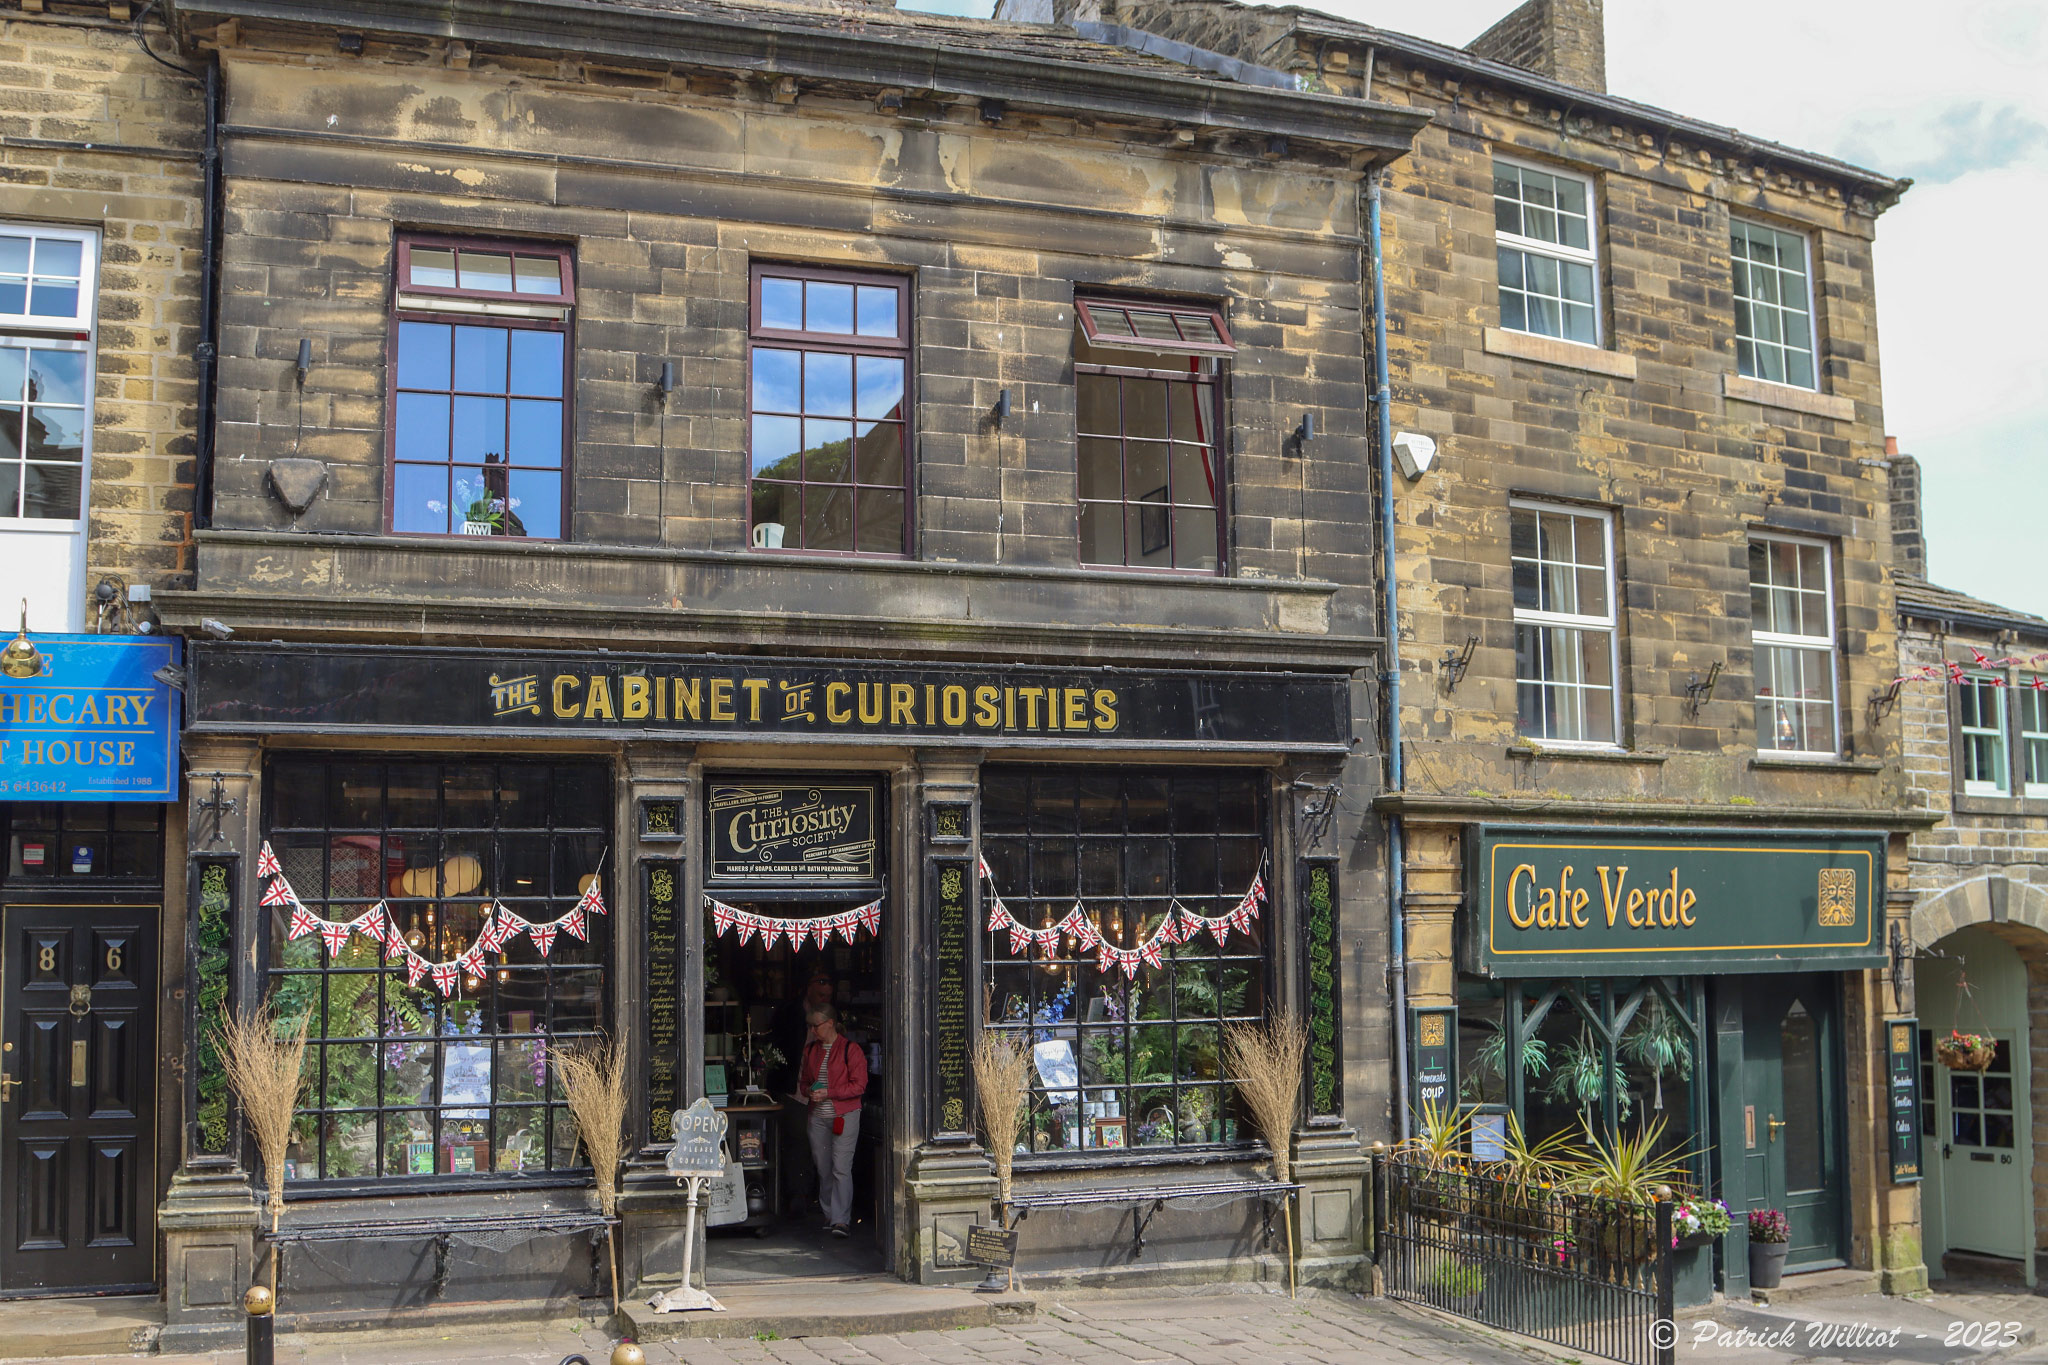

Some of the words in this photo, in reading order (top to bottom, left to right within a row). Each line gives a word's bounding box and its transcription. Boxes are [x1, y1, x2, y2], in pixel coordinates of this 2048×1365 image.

[491, 680, 538, 710] THE
[553, 675, 770, 722] CABINET
[785, 689, 812, 714] OF
[826, 681, 1119, 732] CURIOSITIES
[22, 740, 135, 766] HOUSE
[14, 781, 66, 793] 643642
[88, 776, 129, 785] Established
[132, 777, 152, 786] 1988
[762, 806, 782, 819] THE
[655, 813, 670, 827] 84
[943, 816, 957, 830] 84
[729, 804, 856, 853] Curiosity
[792, 829, 837, 847] SOCIETY
[1506, 863, 1590, 930] Cafe
[1596, 864, 1697, 929] Verde
[39, 946, 55, 971] 8
[106, 945, 122, 970] 6
[1421, 1086, 1444, 1099] SOUP
[681, 1115, 720, 1133] OPEN
[683, 1145, 713, 1153] PLEASE
[680, 1157, 700, 1165] COME
[2000, 1154, 2012, 1165] 80
